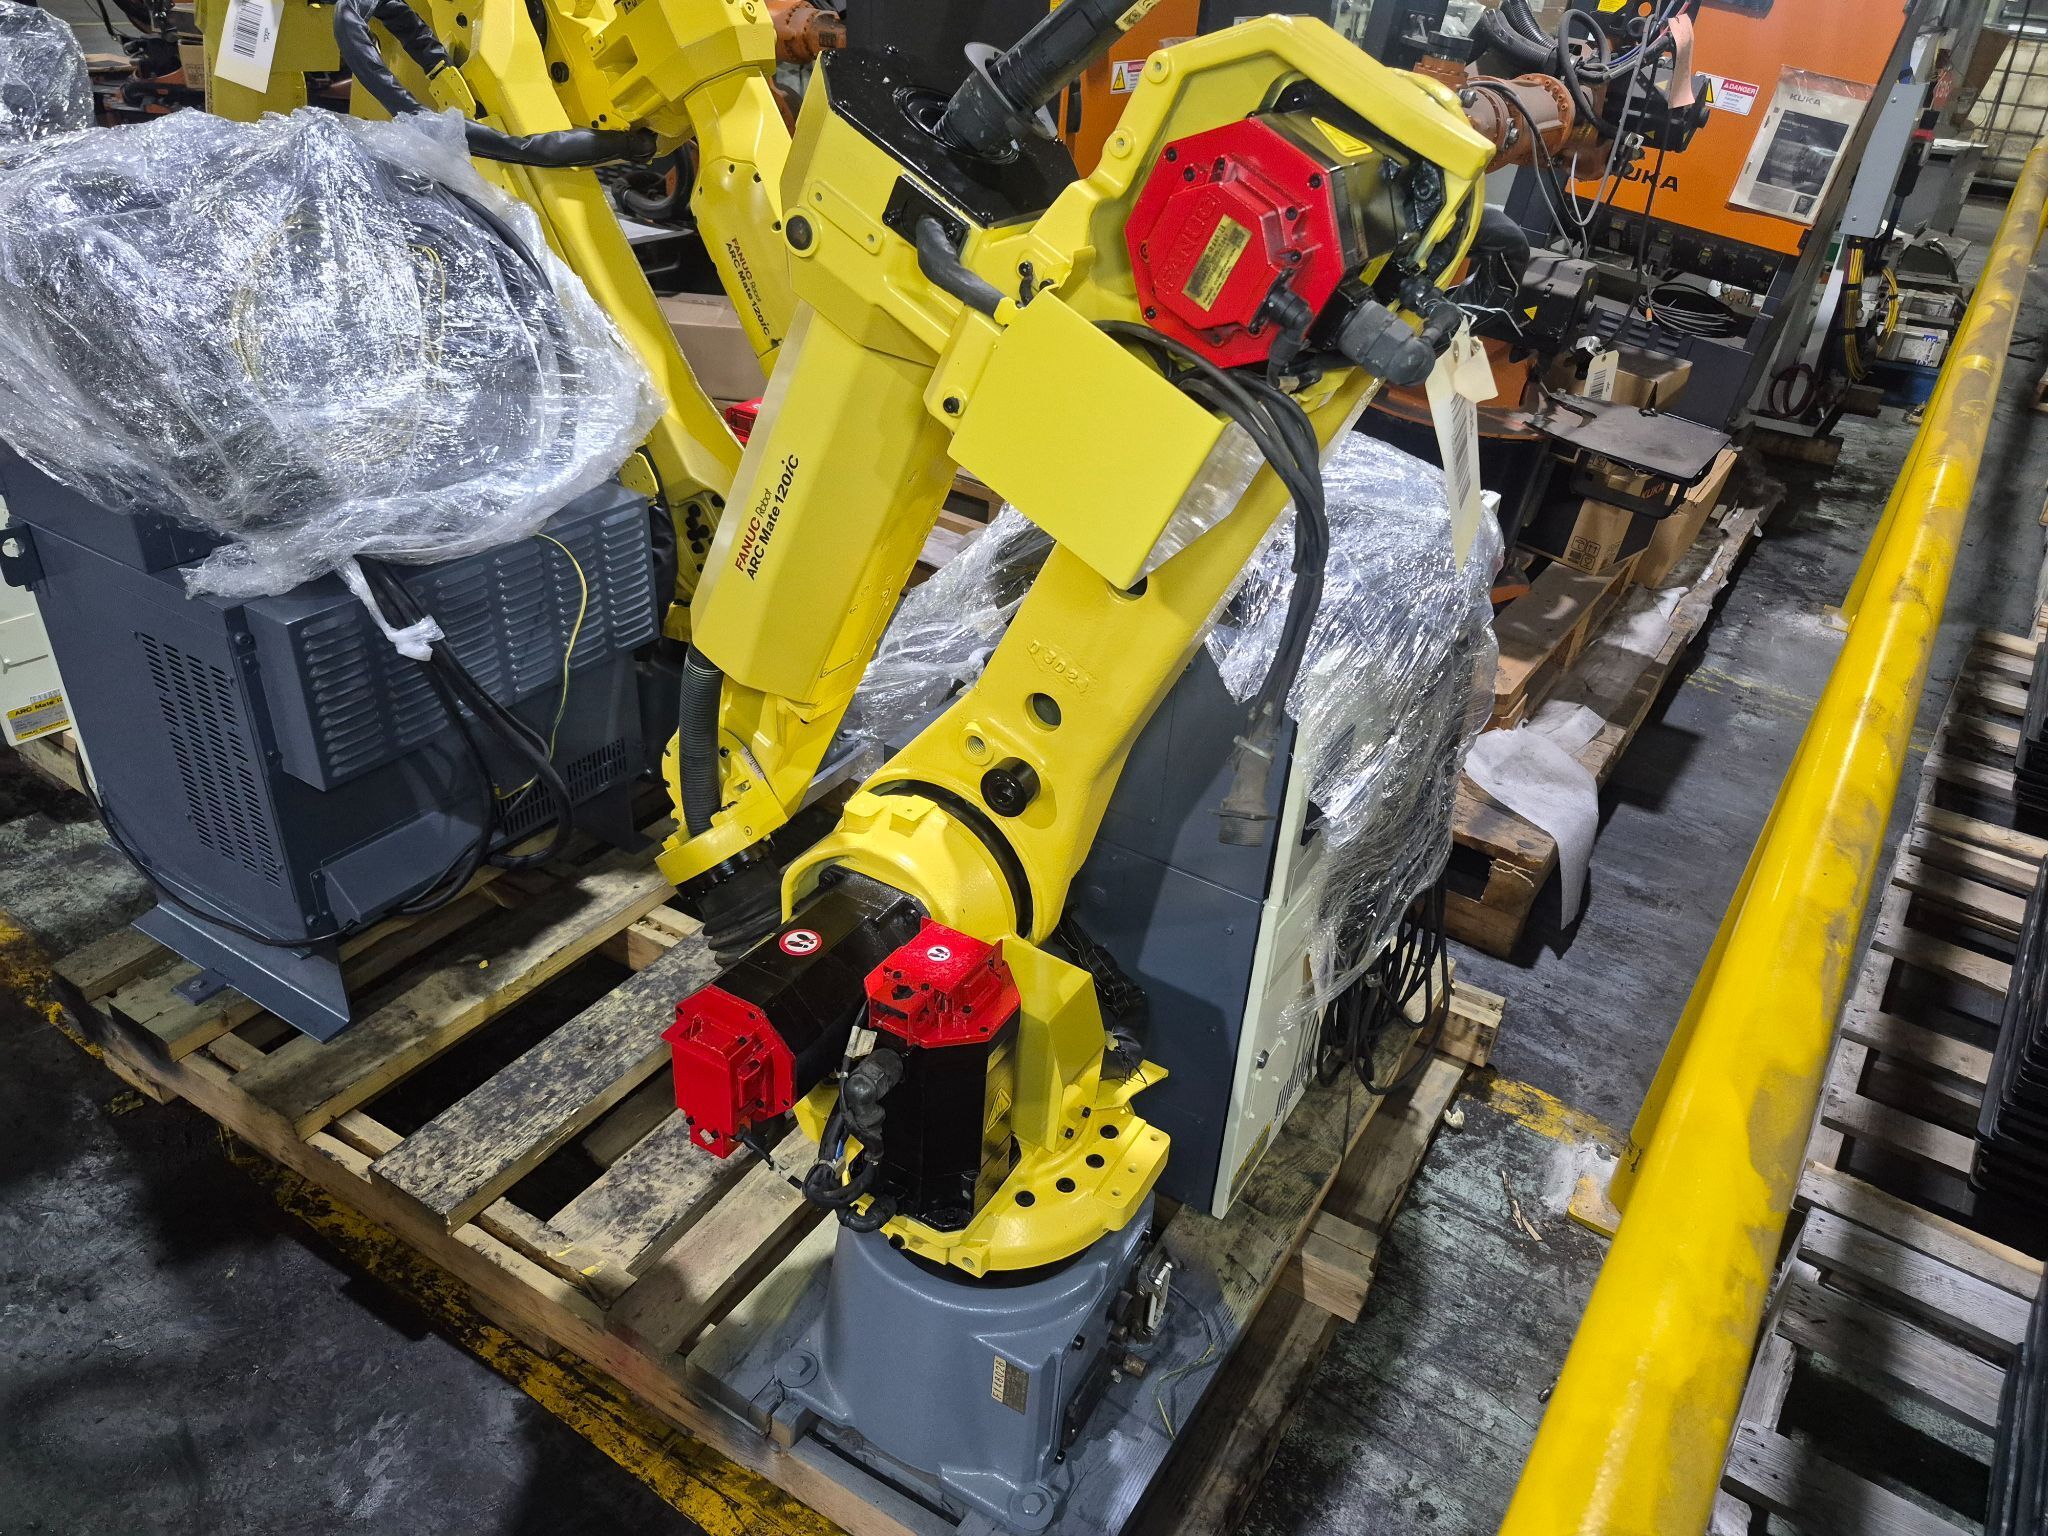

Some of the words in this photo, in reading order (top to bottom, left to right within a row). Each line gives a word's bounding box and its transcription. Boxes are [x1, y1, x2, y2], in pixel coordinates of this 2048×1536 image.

[1729, 83, 1755, 95] DANGER
[1789, 93, 1821, 106] KUKA
[1619, 167, 1678, 192] UKA
[732, 237, 752, 280] FANUC
[726, 243, 740, 268] ARC
[738, 271, 753, 299] Mate
[752, 301, 770, 336] 120iC
[735, 516, 761, 572] FANUC
[755, 488, 772, 518] Robot
[746, 545, 765, 581] ARC
[759, 506, 780, 545] Mate
[774, 454, 799, 503] 120iC
[15, 707, 33, 716] ARC
[34, 700, 54, 710] Mate
